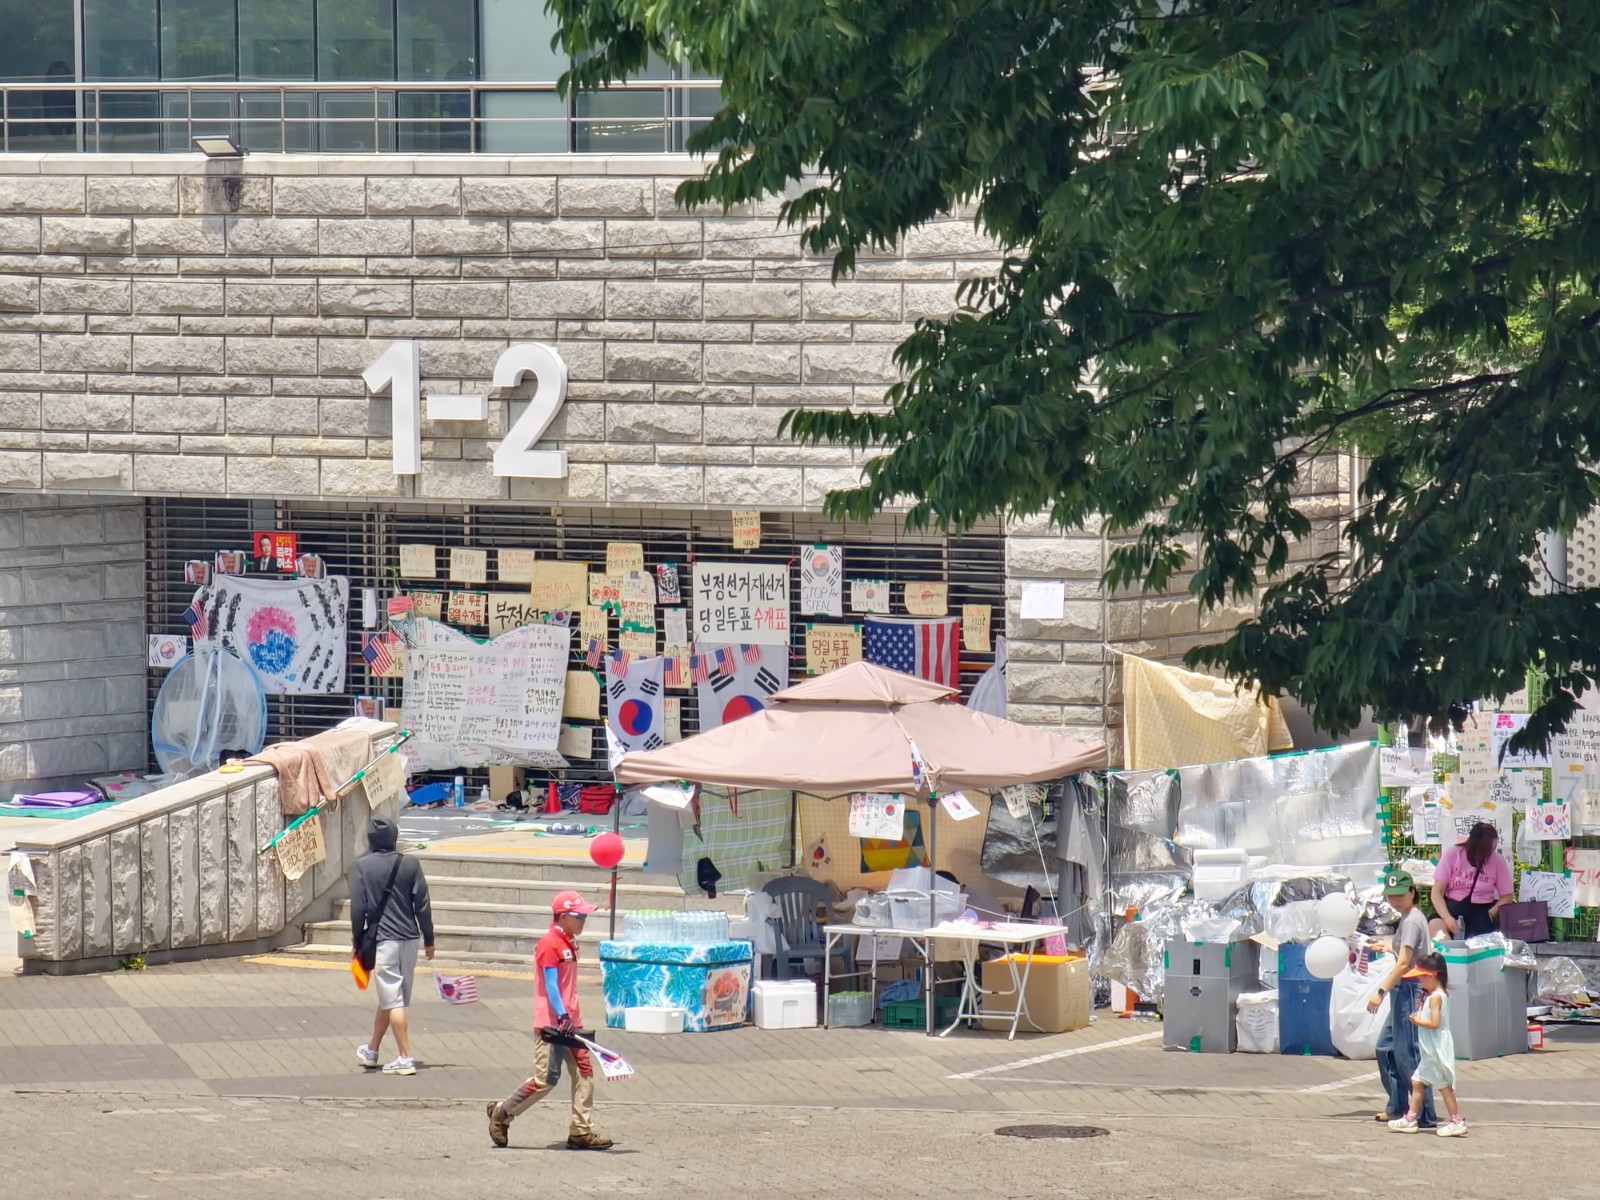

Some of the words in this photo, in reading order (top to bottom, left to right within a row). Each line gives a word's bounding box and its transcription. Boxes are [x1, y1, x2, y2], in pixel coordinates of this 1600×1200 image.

[361, 339, 568, 479] 1-2
[803, 586, 828, 600] STOP
[805, 599, 832, 612] STEAL
[1388, 876, 1397, 887] C
